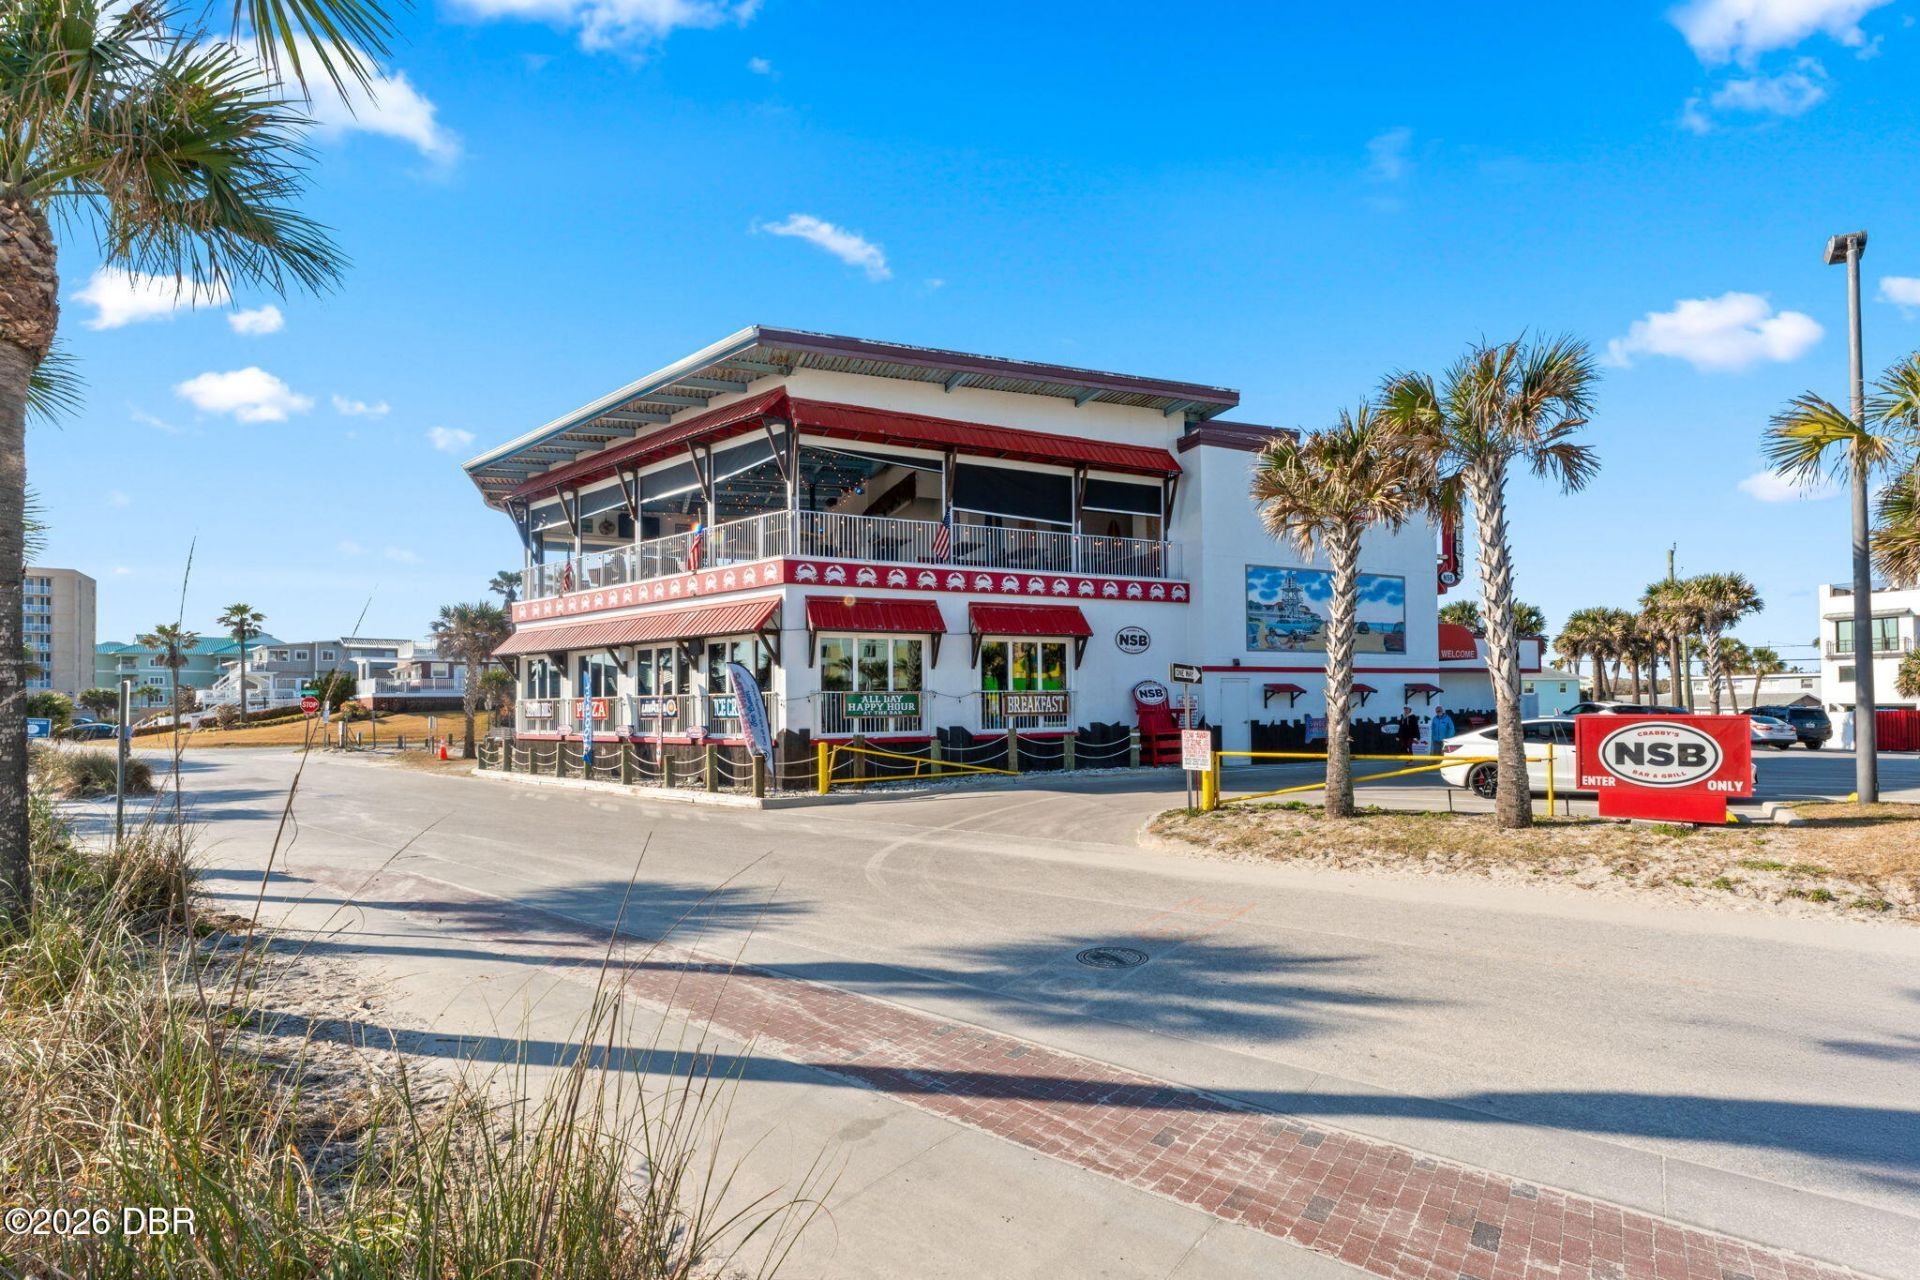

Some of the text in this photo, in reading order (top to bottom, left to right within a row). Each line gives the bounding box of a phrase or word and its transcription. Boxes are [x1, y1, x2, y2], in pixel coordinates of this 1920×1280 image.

[1119, 634, 1148, 647] NSB
[1441, 649, 1475, 659] WELCOME
[862, 695, 903, 703] ALL DAY
[1139, 688, 1164, 699] NSB
[848, 702, 916, 711] HAPPY HOUR
[1007, 695, 1065, 713] BREAKFAST
[1614, 742, 1708, 767] NSB
[1632, 769, 1650, 778] BAR
[1582, 775, 1616, 787] ENTER
[1707, 780, 1744, 792] ONLY
